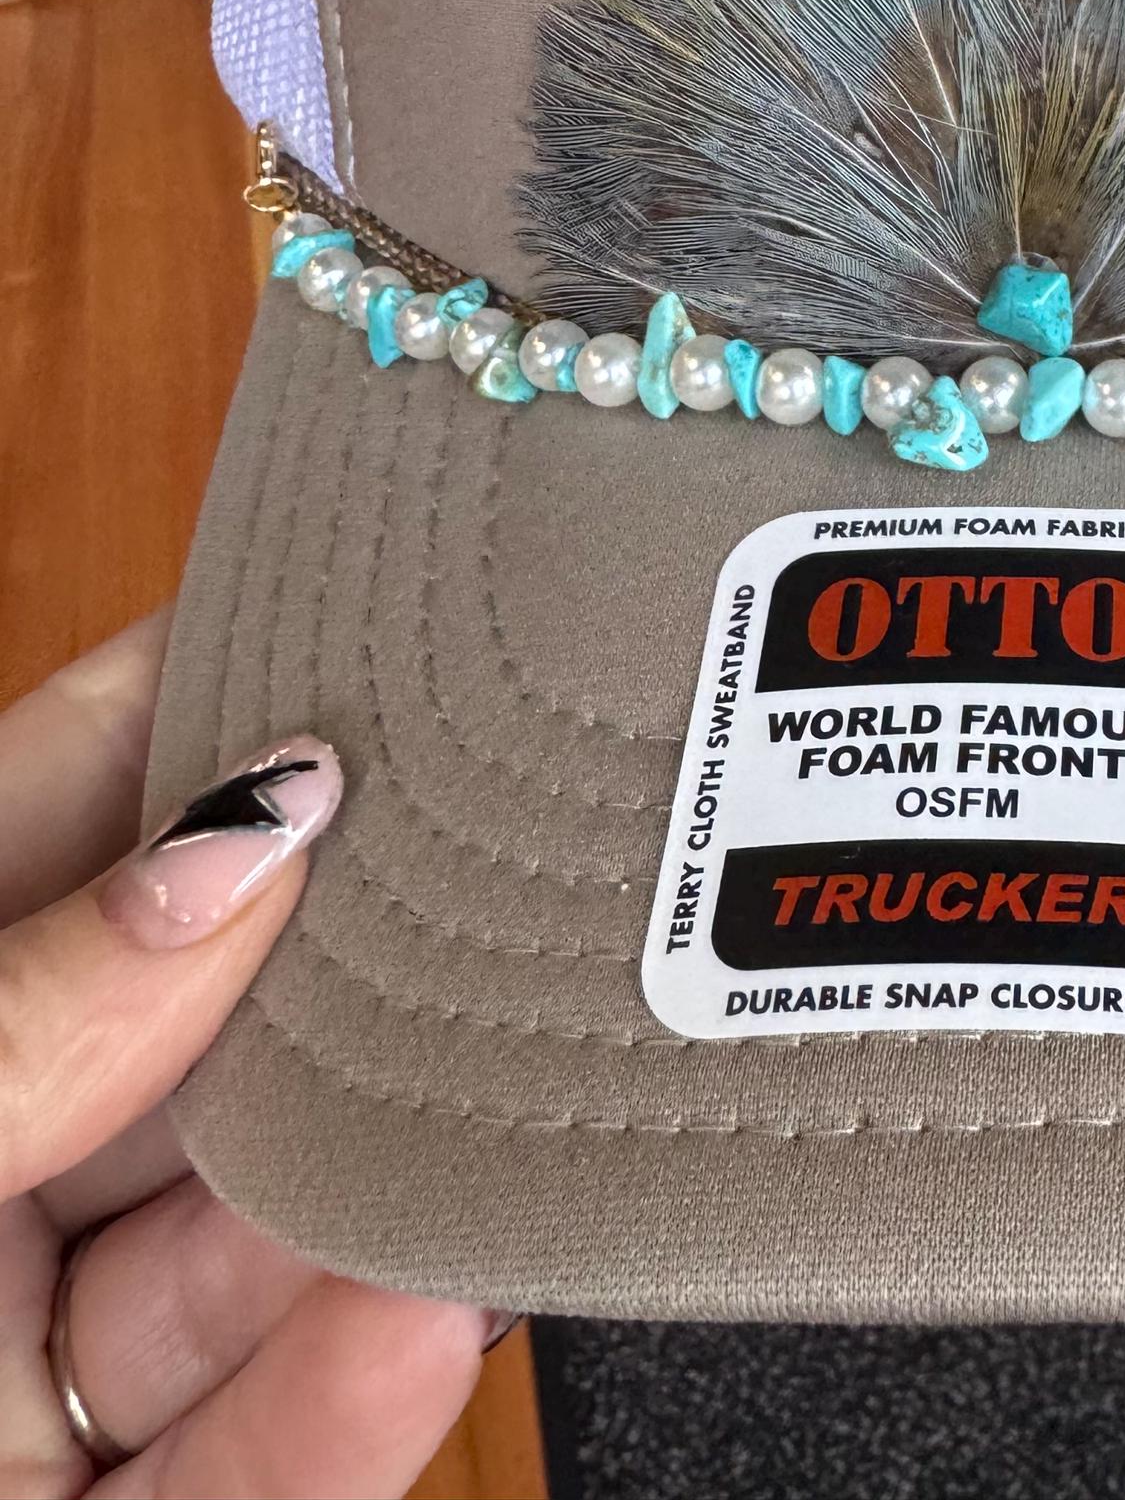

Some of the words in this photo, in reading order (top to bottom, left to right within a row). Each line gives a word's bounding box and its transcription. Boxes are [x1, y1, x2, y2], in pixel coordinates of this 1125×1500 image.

[814, 518, 943, 540] PREMIUM
[953, 518, 1036, 536] FOAM
[768, 704, 942, 743] WORLD
[665, 861, 705, 955] TERRY
[687, 759, 725, 851] CLOTH
[715, 583, 756, 749] SWEATBAND
[798, 742, 939, 780] FOAM
[895, 786, 1019, 819] OSFM
[725, 984, 873, 1017] DURABLE
[884, 983, 979, 1009] SNAP
